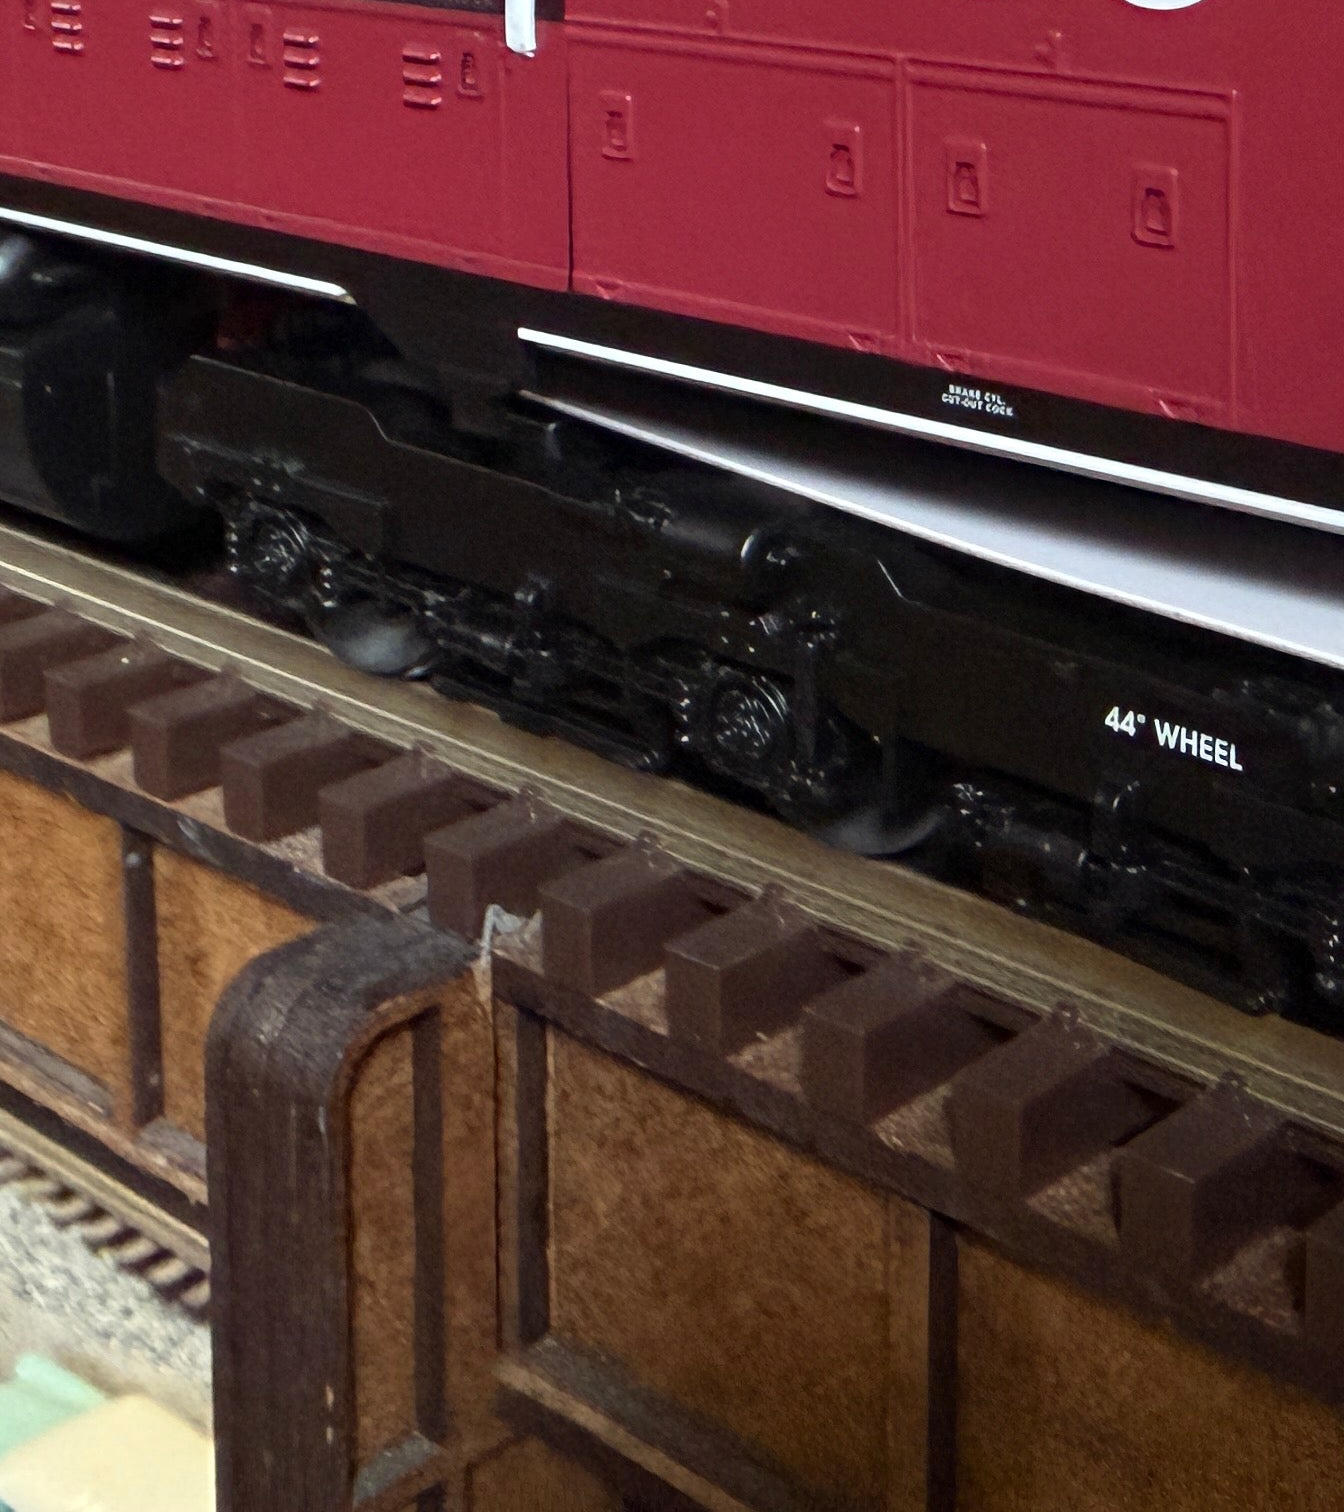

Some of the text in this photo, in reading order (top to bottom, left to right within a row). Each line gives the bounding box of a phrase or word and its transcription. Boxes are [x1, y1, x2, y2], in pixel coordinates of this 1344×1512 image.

[941, 393, 1015, 417] CUT-OUT COCK
[1154, 718, 1244, 772] WHEEL
